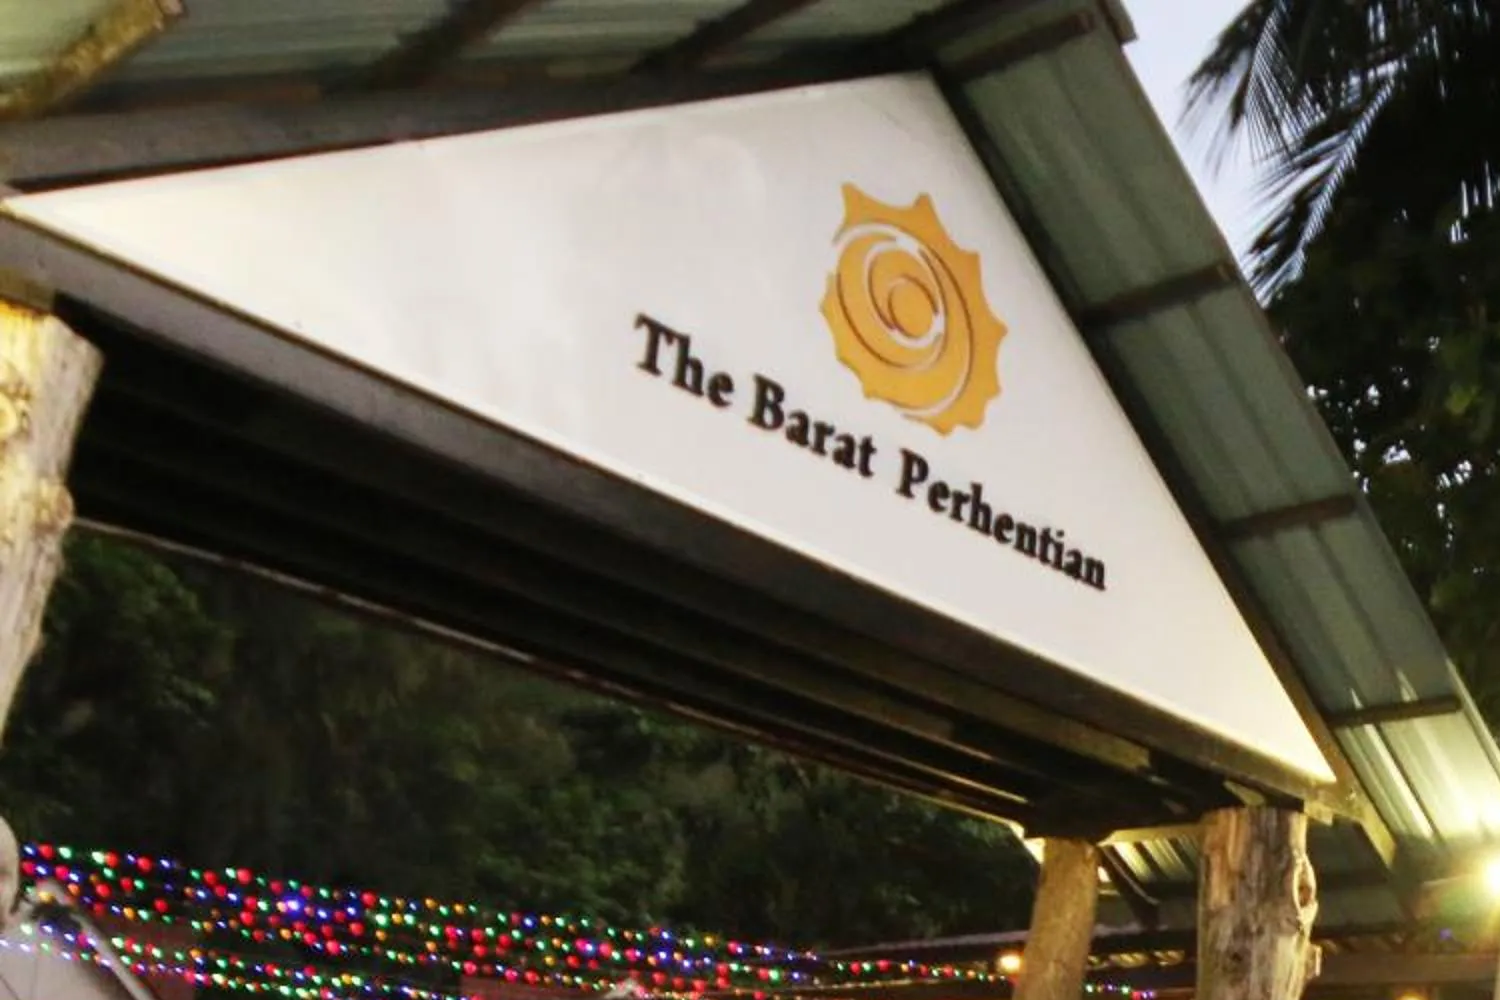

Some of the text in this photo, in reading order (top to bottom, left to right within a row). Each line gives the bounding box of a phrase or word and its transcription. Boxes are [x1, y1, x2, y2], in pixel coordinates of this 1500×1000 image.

[634, 313, 1107, 592] The Barat Perhentian
